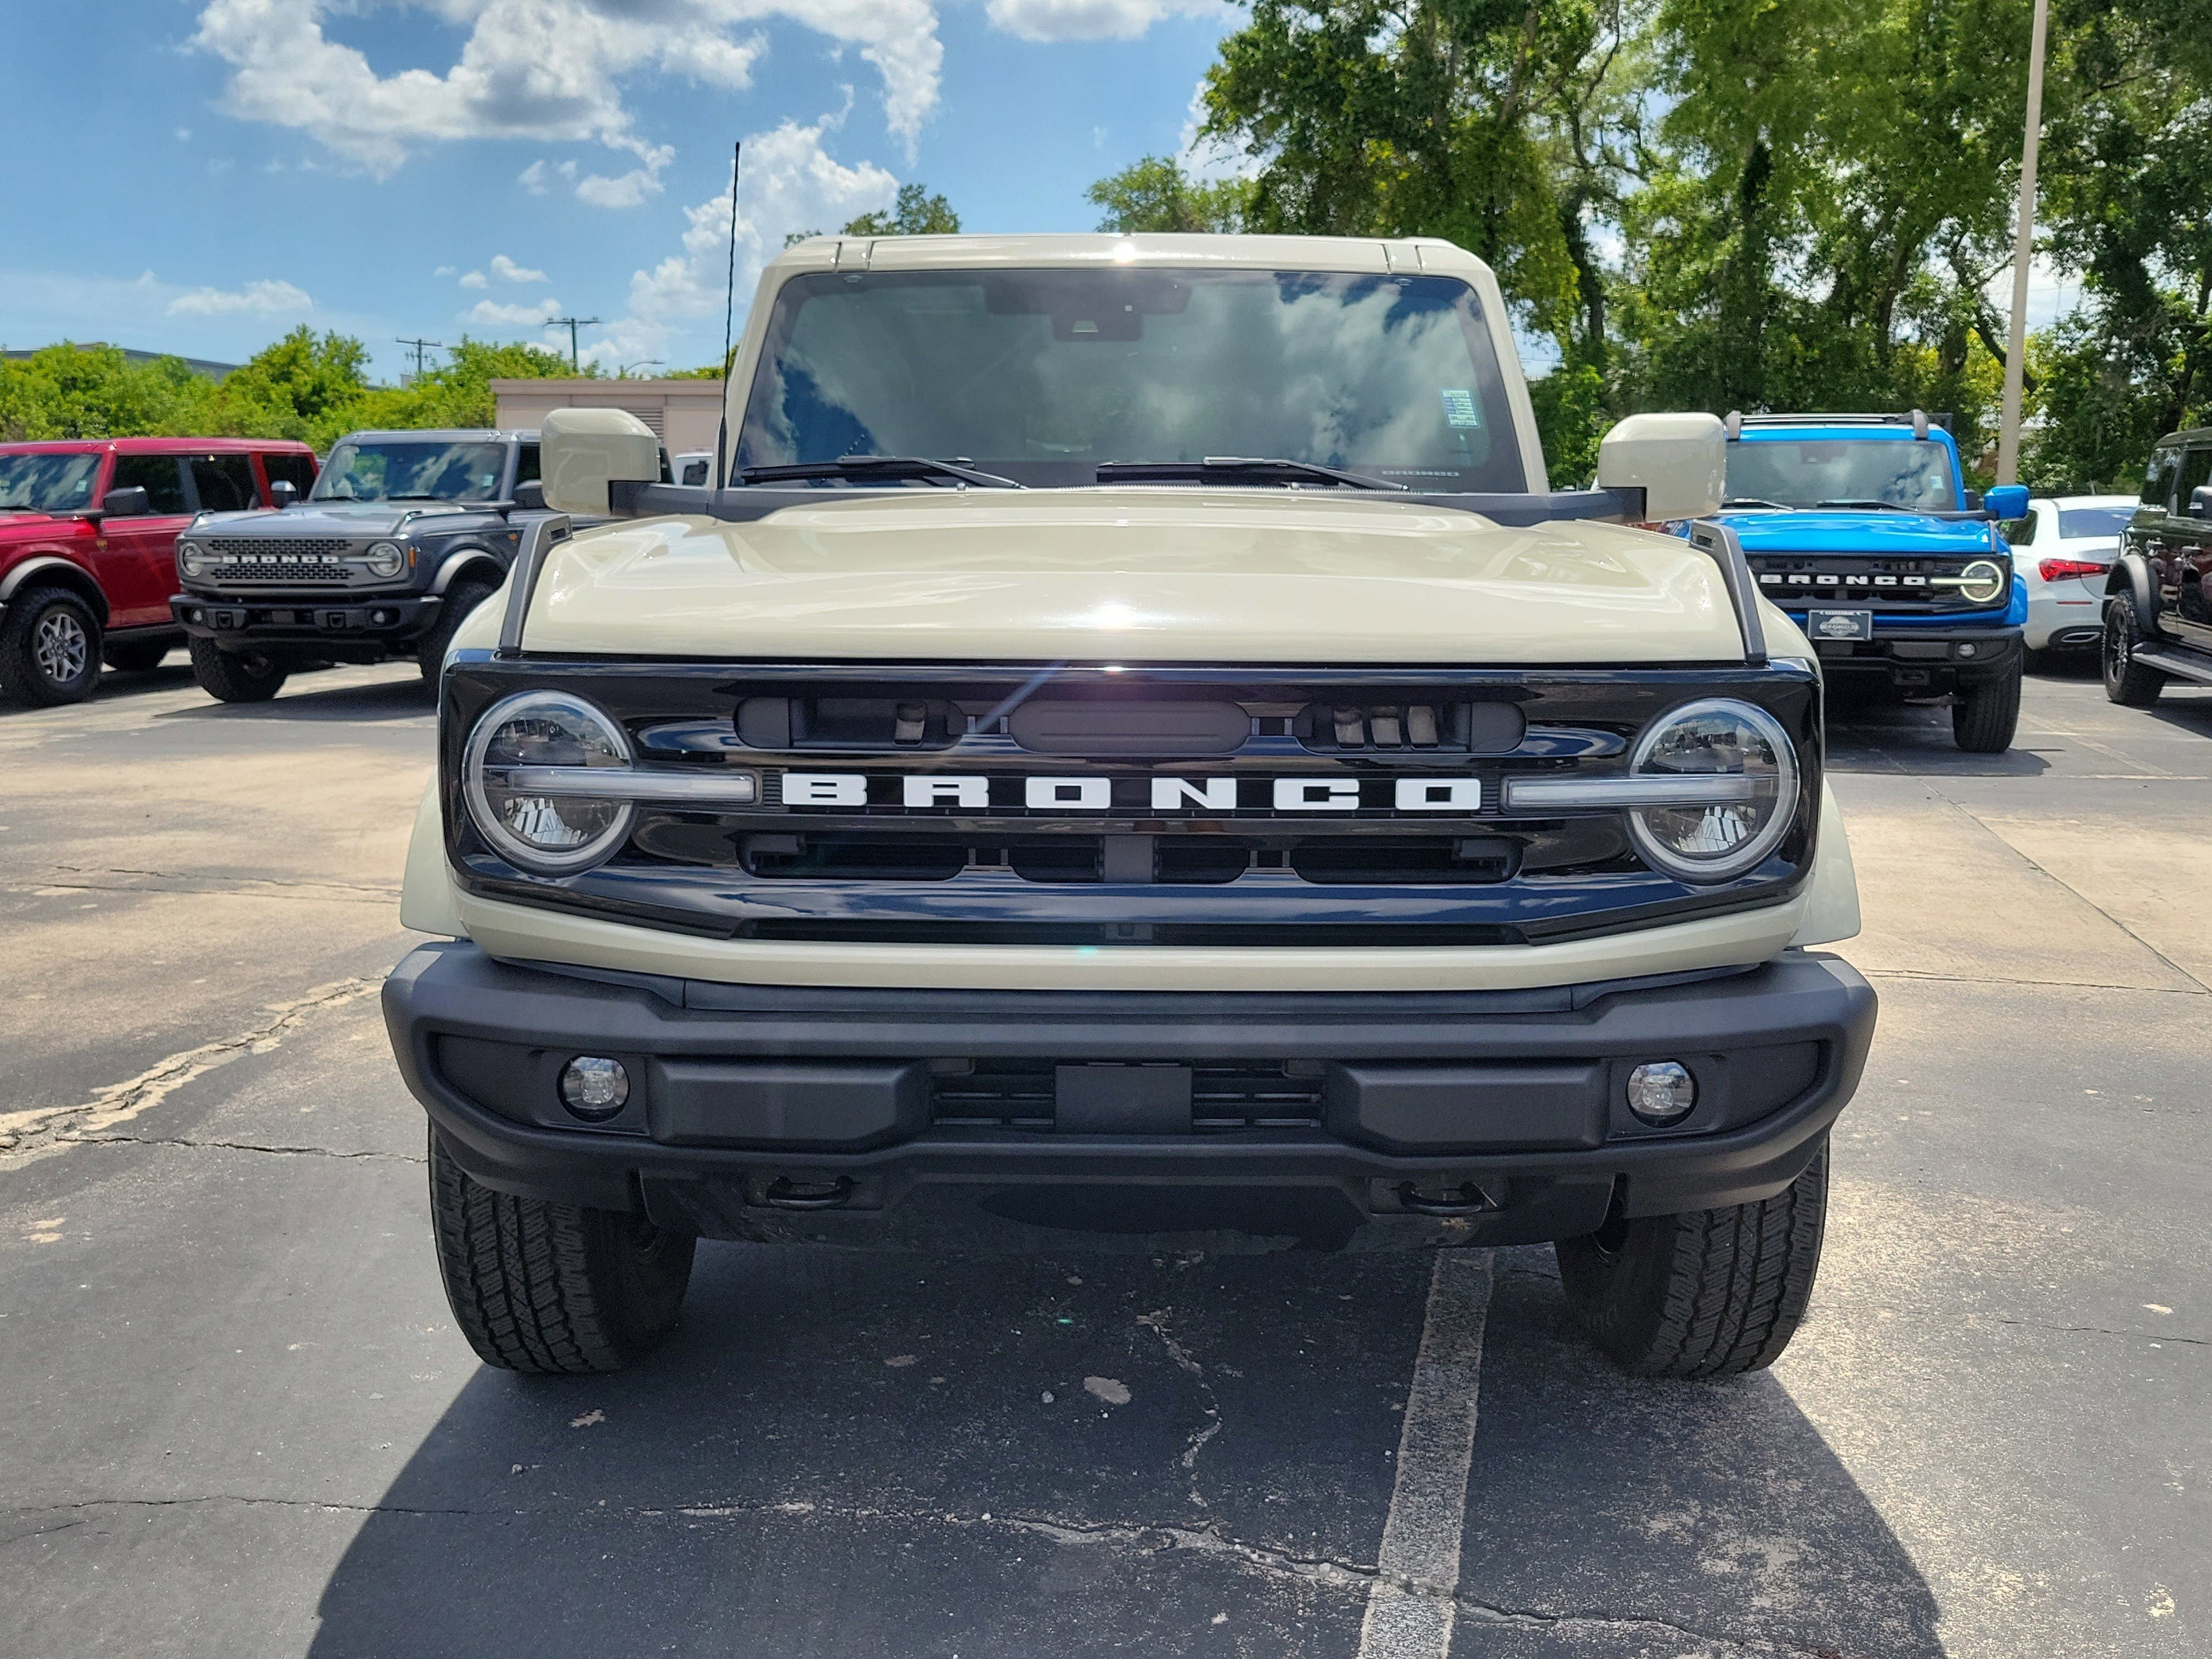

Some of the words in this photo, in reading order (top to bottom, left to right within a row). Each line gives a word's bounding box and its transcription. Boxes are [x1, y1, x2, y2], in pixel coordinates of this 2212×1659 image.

[223, 556, 338, 564] BRONCO
[1760, 574, 1926, 586] BRONCO
[782, 773, 1481, 810] BRONCO
